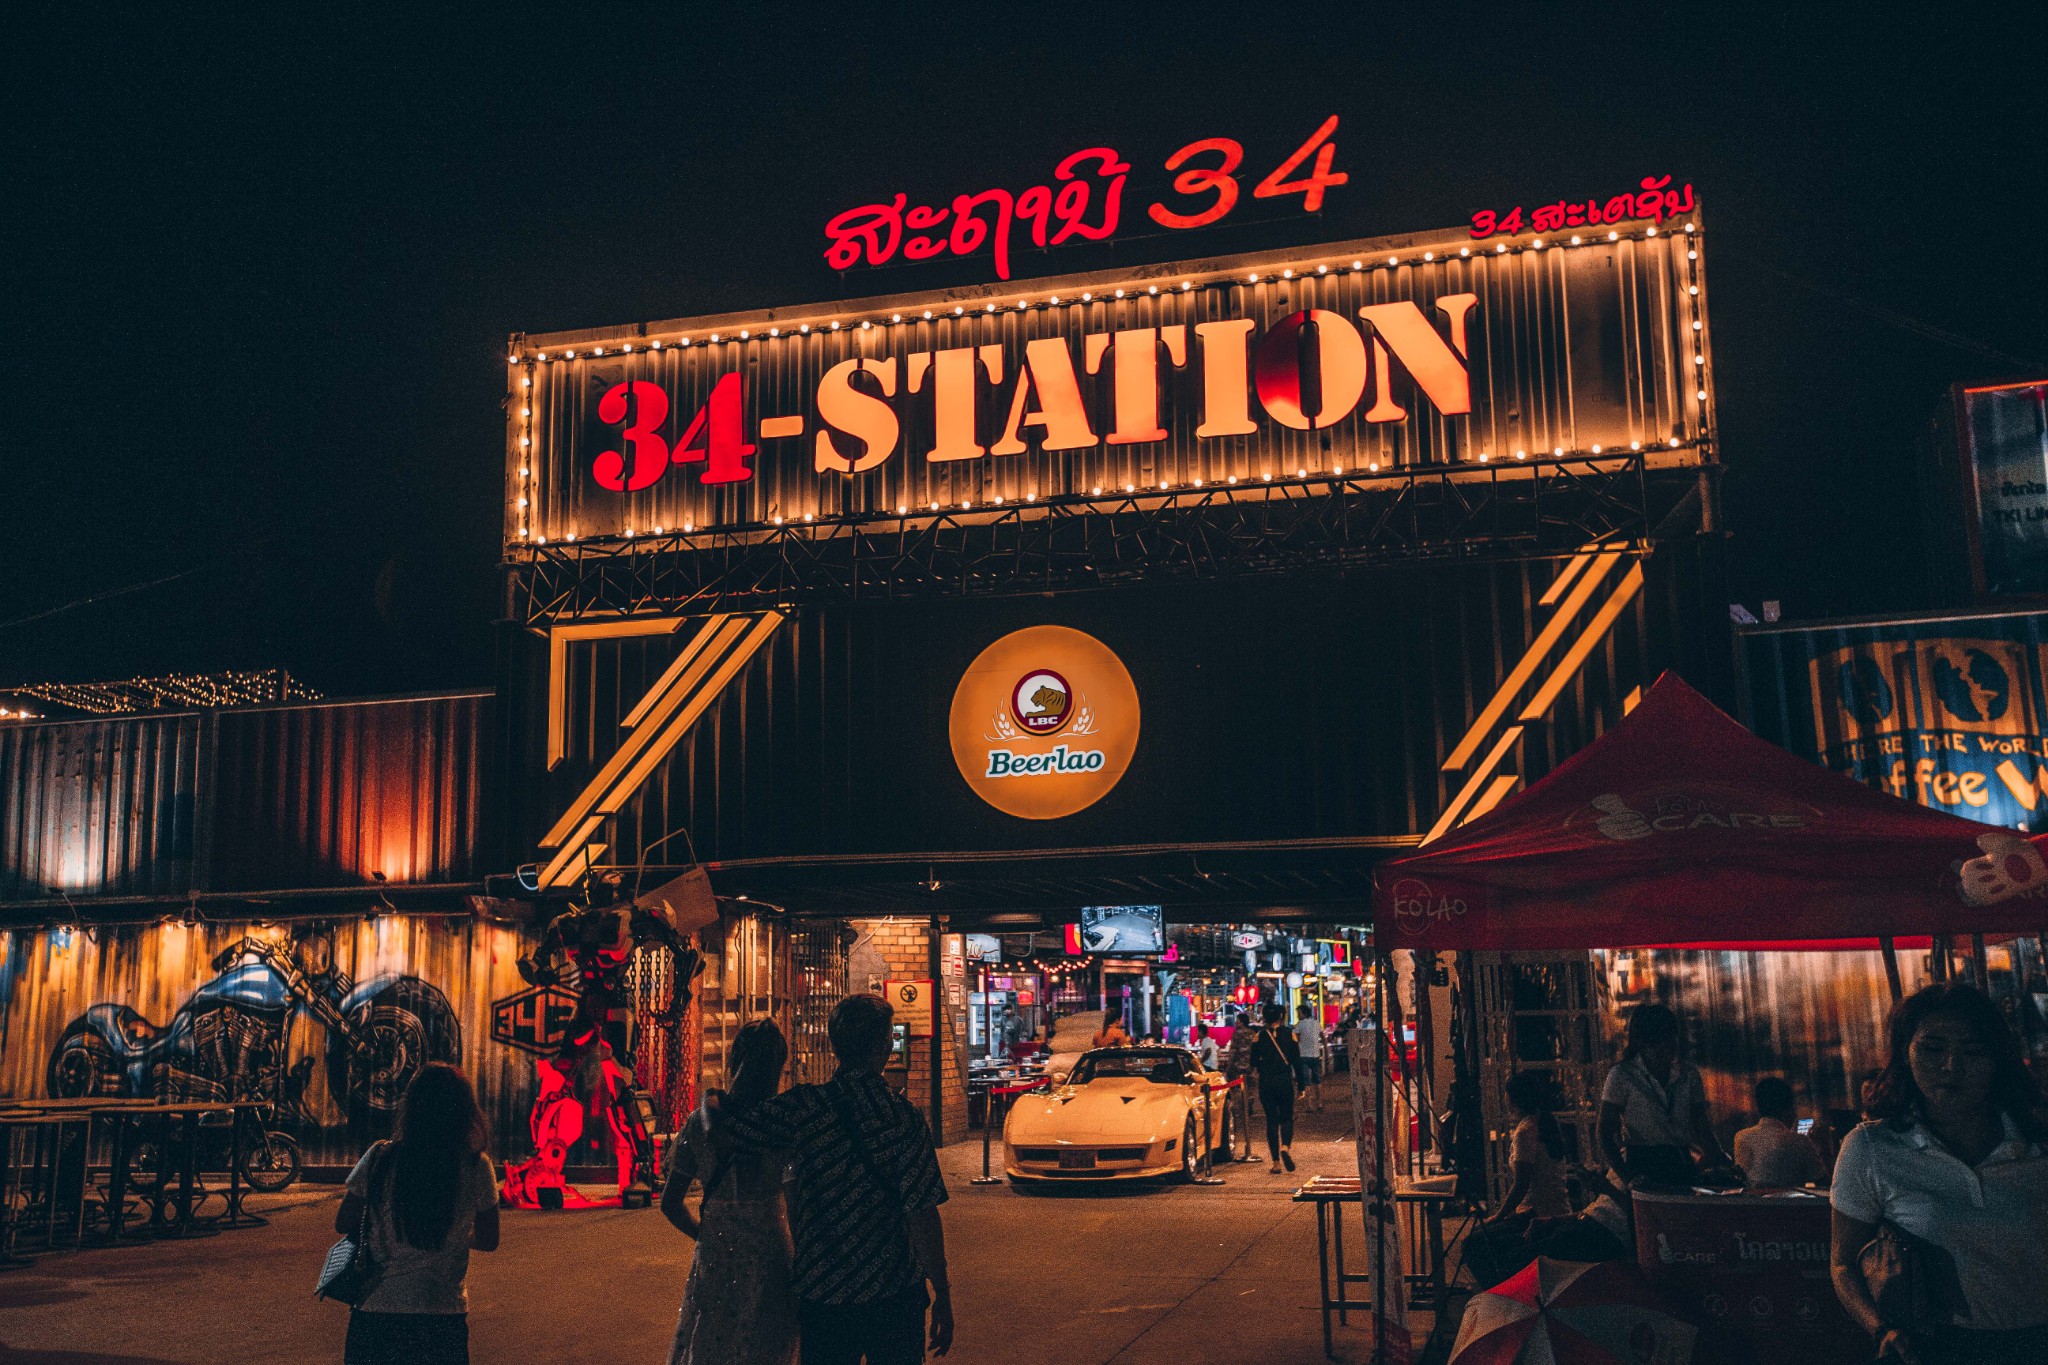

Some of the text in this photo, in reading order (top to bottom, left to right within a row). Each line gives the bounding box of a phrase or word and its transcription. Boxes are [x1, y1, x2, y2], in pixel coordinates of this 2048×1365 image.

[1148, 115, 1348, 228] 34
[1469, 206, 1524, 237] 34
[1028, 715, 1059, 726] LBC
[1919, 733, 1968, 755] THE
[987, 746, 1104, 776] Beerlao
[1651, 812, 1807, 832] CARE
[1393, 894, 1468, 922] KOLAO
[1673, 1251, 1717, 1264] CARE
